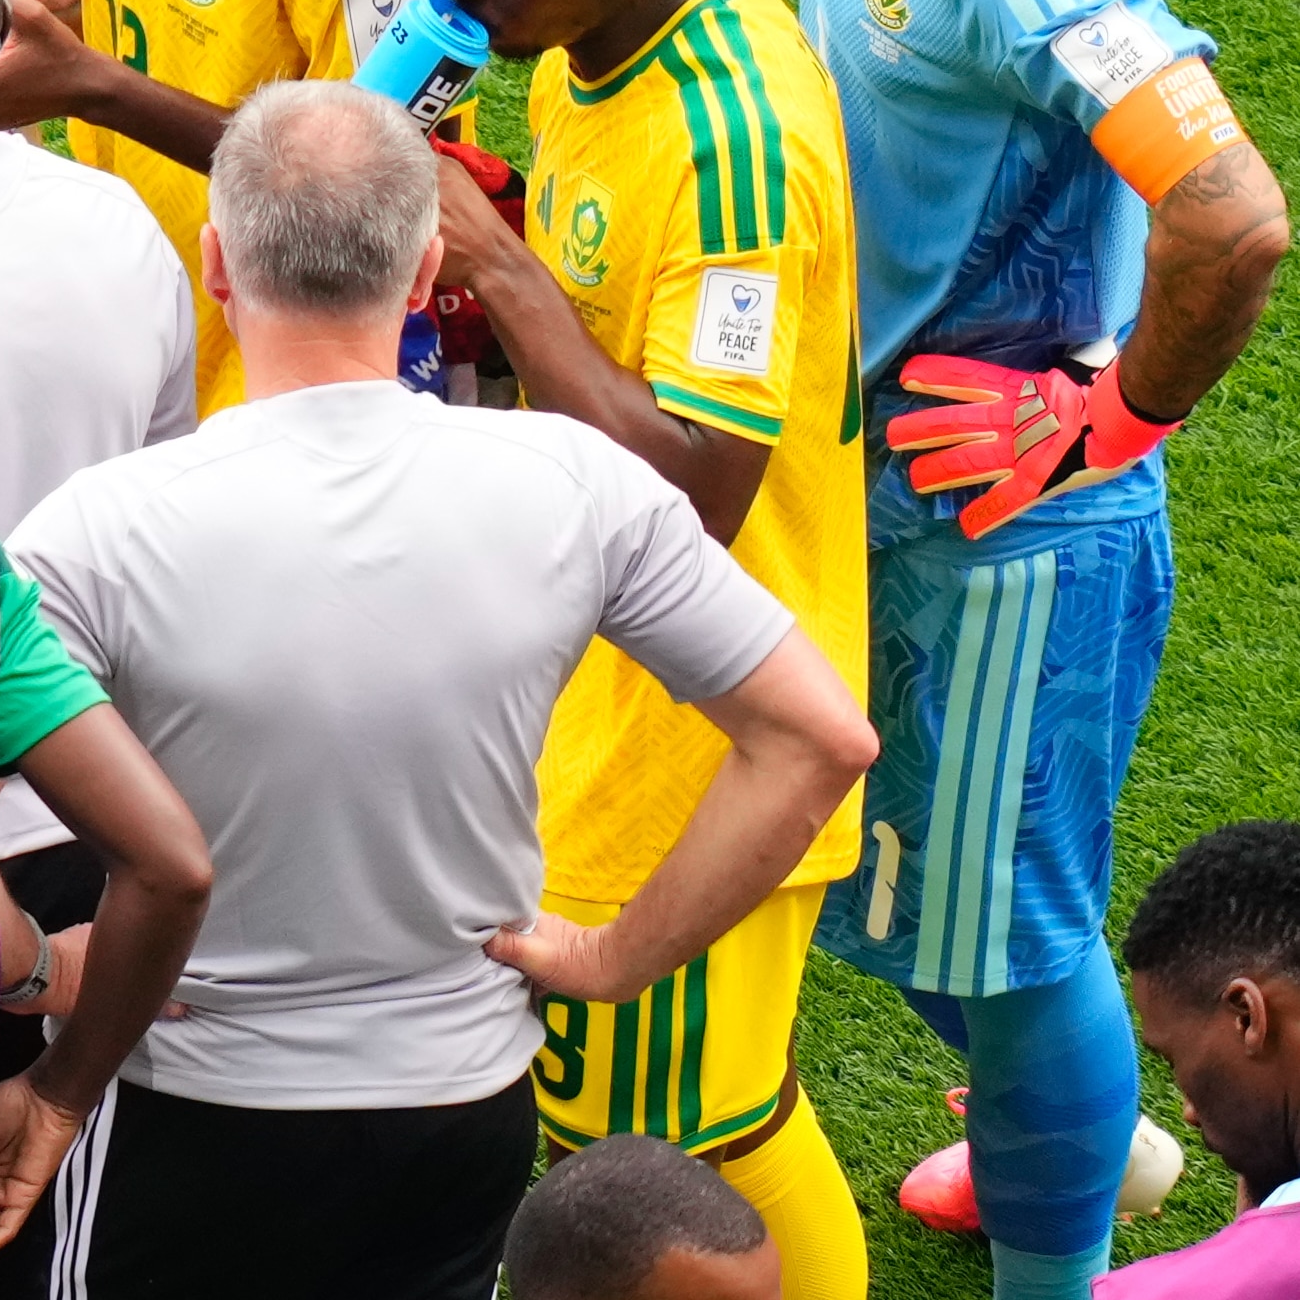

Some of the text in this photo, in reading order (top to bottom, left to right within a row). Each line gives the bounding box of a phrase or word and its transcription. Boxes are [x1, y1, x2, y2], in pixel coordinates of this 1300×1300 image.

[391, 21, 409, 45] 23
[1106, 46, 1143, 82] PEACE
[1124, 67, 1144, 84] FIFA
[1176, 116, 1208, 141] the
[1214, 127, 1235, 140] FIFA
[718, 312, 763, 334] Unite For
[719, 331, 758, 352] PEACE
[724, 351, 745, 361] FIFA
[866, 820, 900, 940] 1
